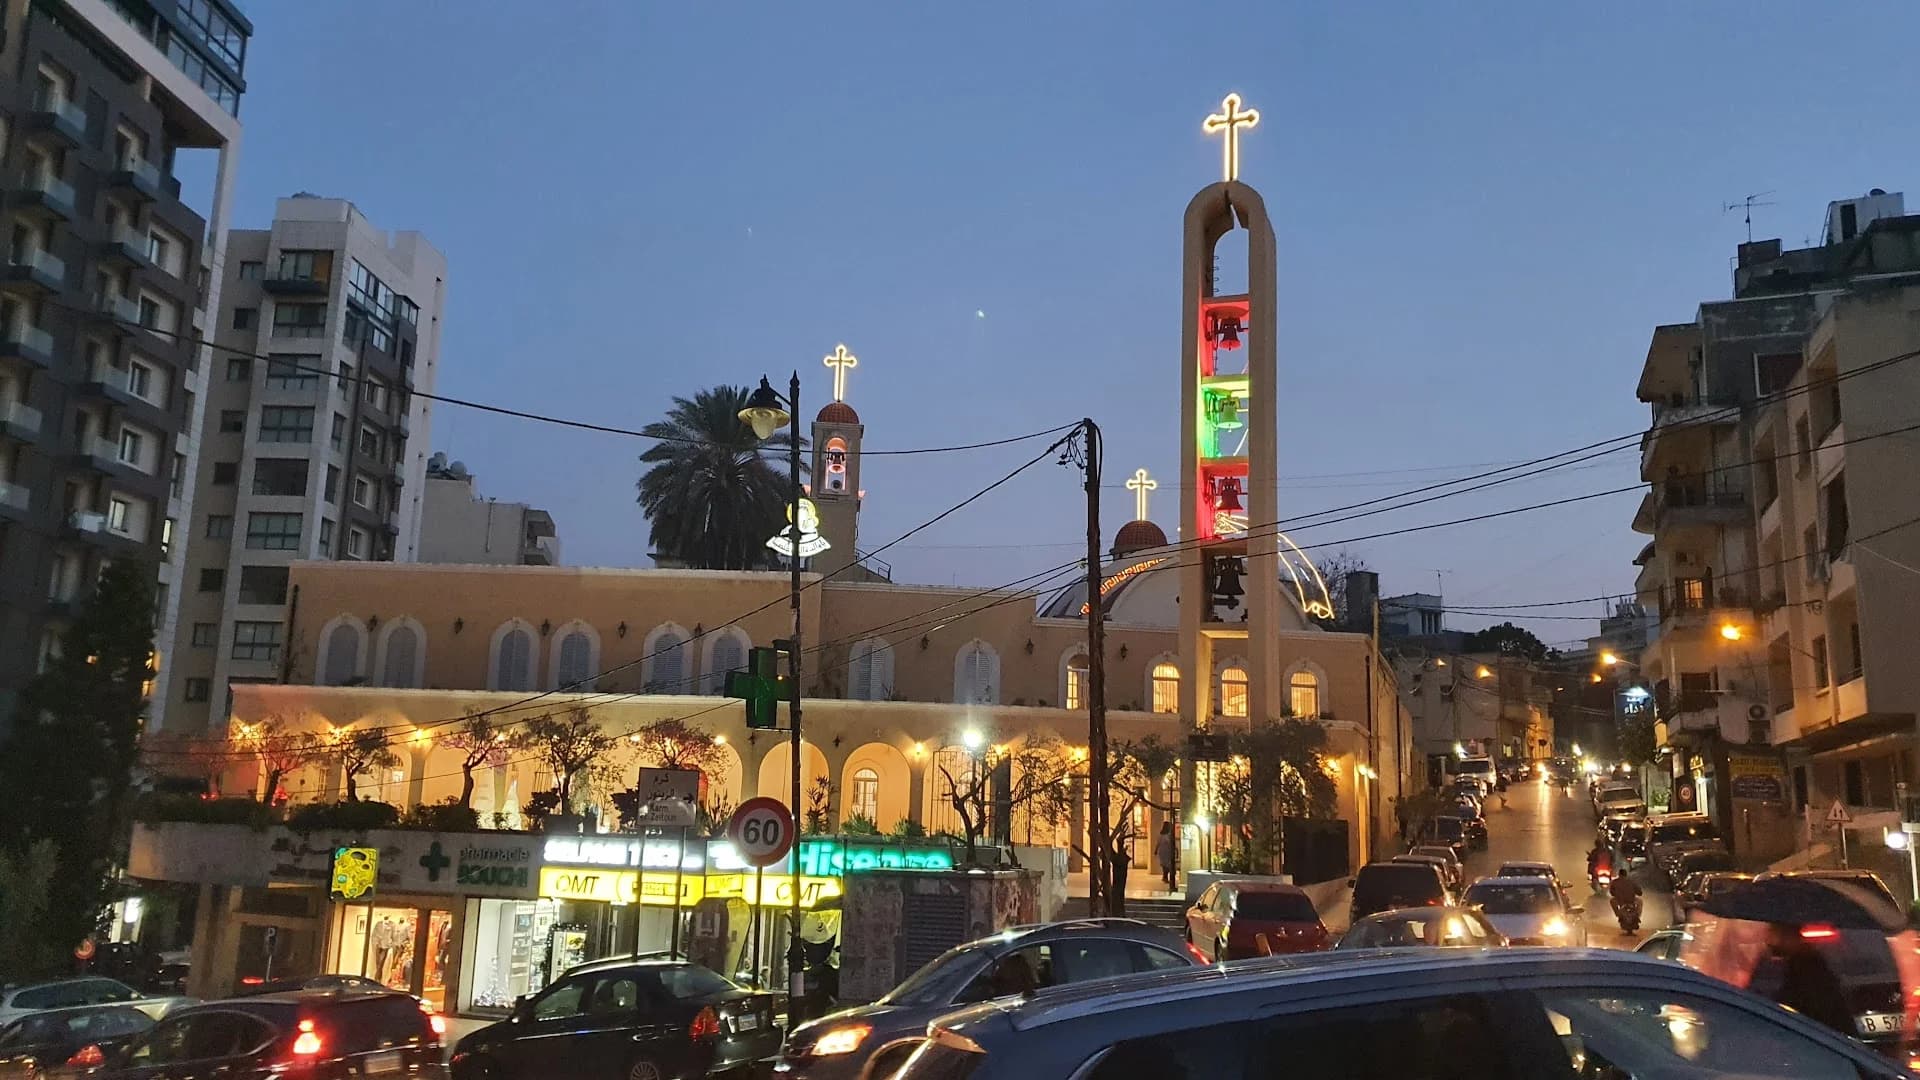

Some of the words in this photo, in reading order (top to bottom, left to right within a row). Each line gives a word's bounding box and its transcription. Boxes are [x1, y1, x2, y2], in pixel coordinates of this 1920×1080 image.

[743, 819, 779, 846] 60
[555, 873, 600, 894] OMT
[1865, 1018, 1876, 1031] B
